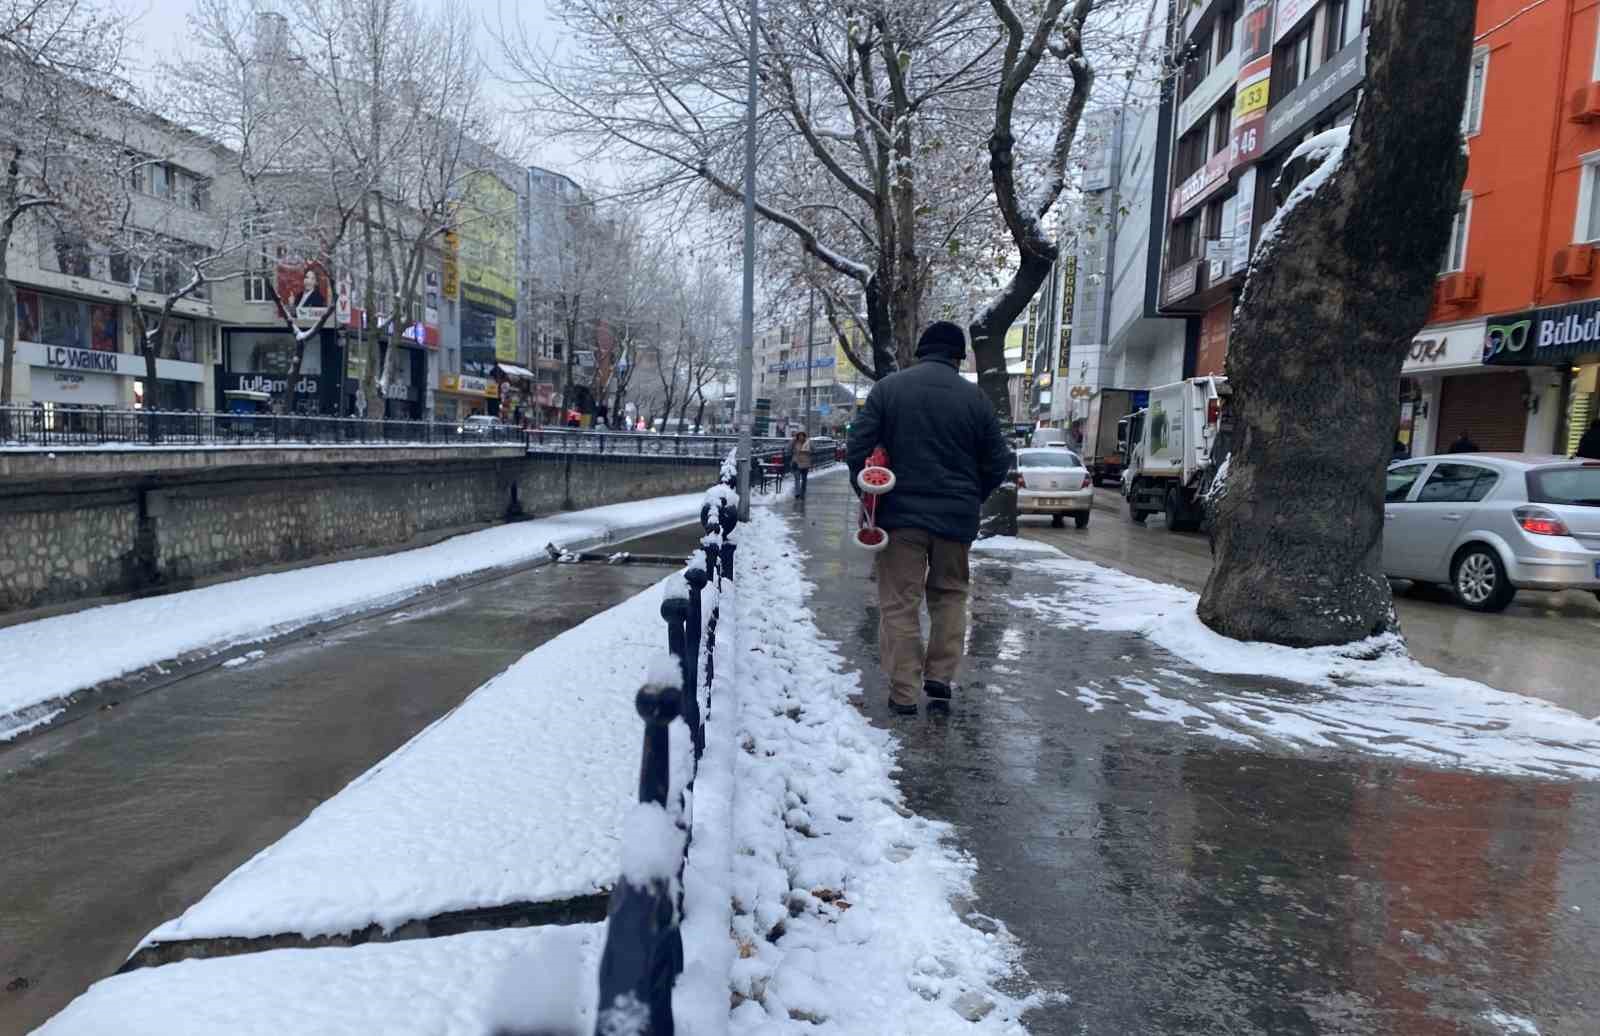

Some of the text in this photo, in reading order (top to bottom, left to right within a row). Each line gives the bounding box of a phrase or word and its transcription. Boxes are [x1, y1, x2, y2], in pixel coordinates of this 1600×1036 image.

[1240, 128, 1257, 154] 46
[47, 346, 65, 365] LC
[239, 375, 317, 393] fullamda
